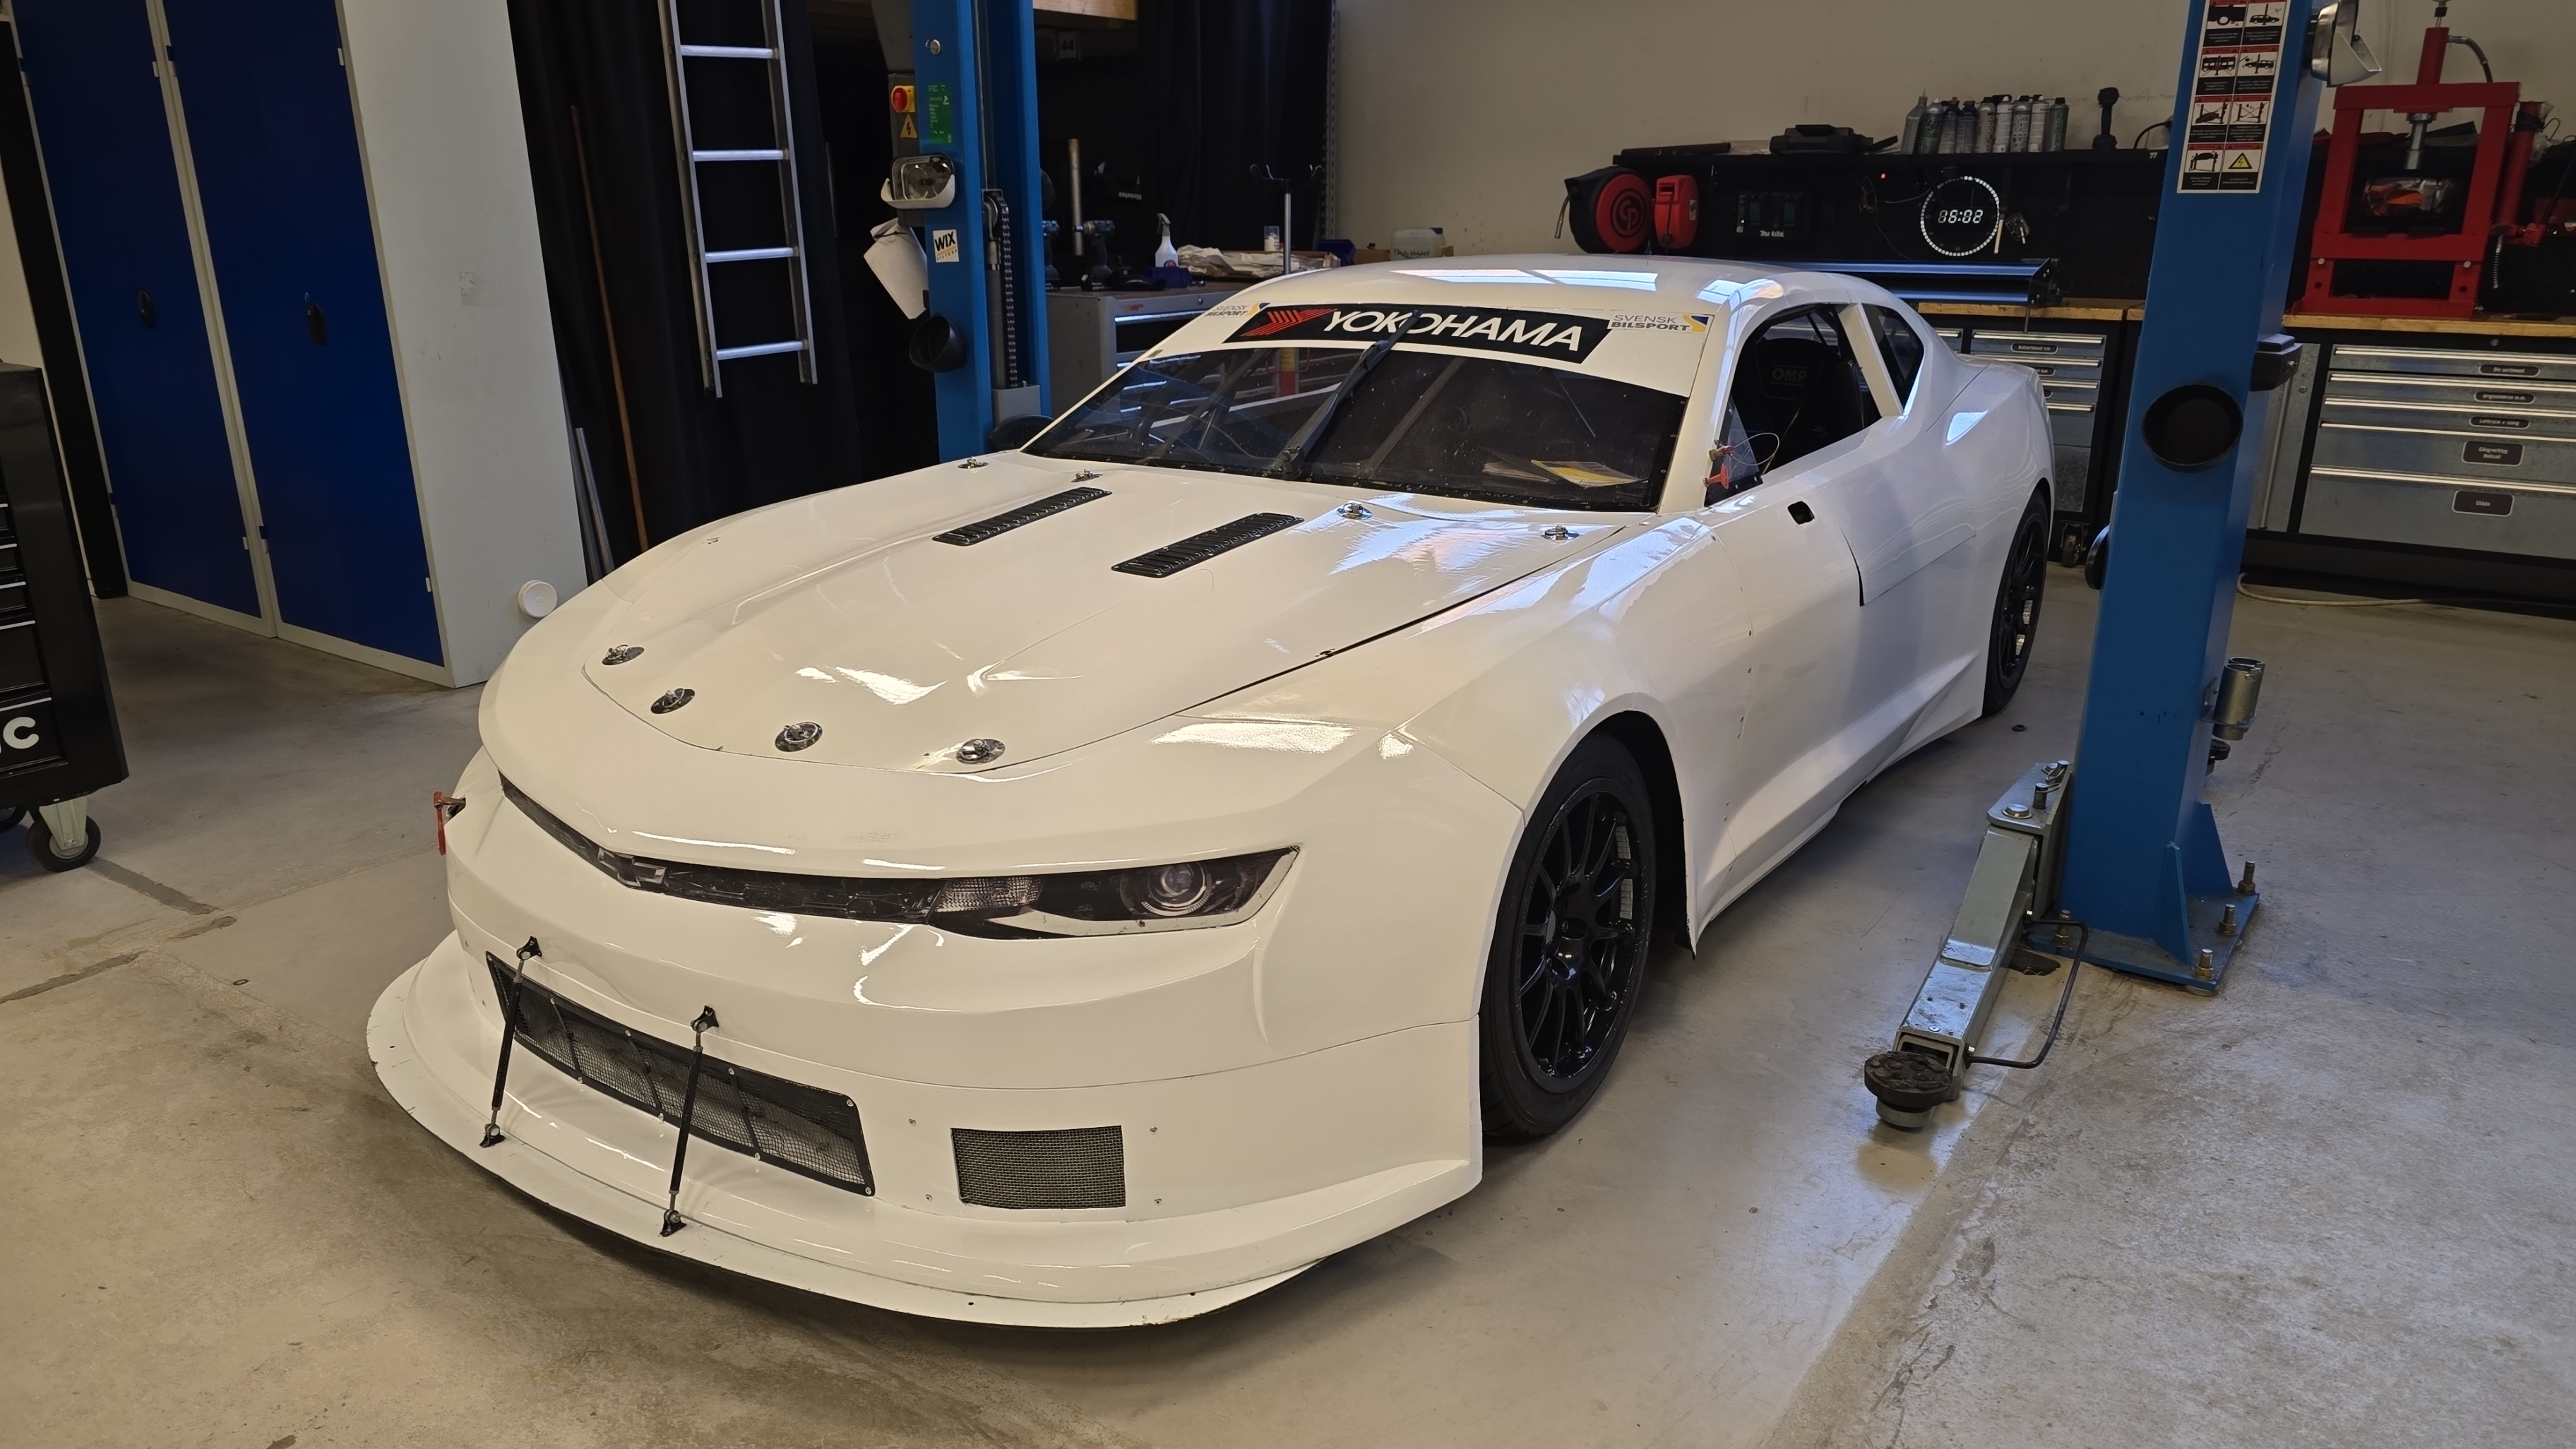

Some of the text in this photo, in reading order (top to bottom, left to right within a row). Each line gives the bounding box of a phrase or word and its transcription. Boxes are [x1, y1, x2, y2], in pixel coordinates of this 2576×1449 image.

[1061, 40, 1073, 52] 44
[934, 231, 956, 251] WIX
[1614, 314, 1677, 324] SVENSK
[1323, 310, 1582, 352] YOKOHAMA
[1611, 321, 1690, 331] BILSPORT
[1771, 368, 1808, 383] OMP
